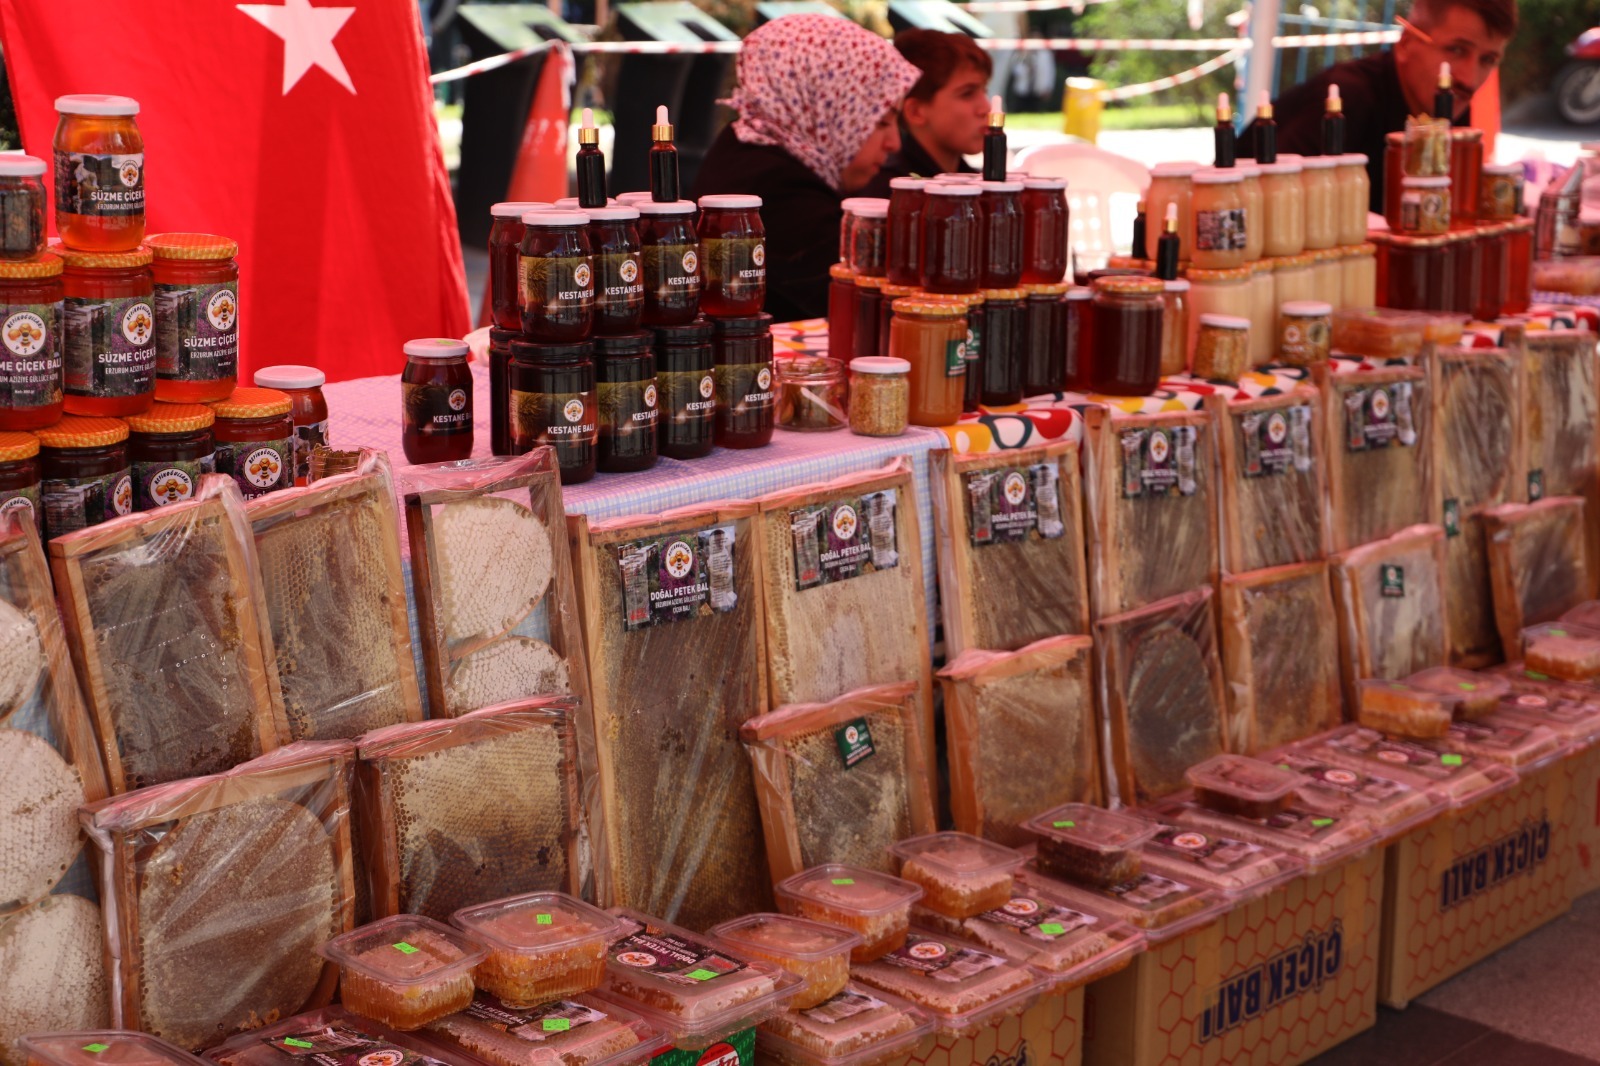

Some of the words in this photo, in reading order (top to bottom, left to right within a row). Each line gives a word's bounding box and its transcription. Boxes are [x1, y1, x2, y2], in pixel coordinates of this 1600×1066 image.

[91, 190, 122, 201] SÜZME
[124, 190, 142, 201] ÇİÇEK
[740, 269, 764, 278] KESTANE
[668, 276, 696, 286] KESTANE
[559, 290, 589, 300] KESTANE
[605, 285, 636, 296] KESTANE
[184, 336, 216, 348] SÜZME
[99, 351, 132, 363] SÜZME
[134, 348, 153, 362] ÇİÇEK
[16, 359, 45, 372] ÇİÇEK
[47, 358, 61, 369] BALI
[745, 392, 769, 402] KESTANE
[686, 400, 712, 411] KESTANE
[433, 413, 465, 423] KESTANE
[632, 409, 656, 421] KESTANE
[547, 425, 582, 434] KESTANE
[820, 550, 840, 562] DOĞAL
[841, 545, 860, 557] PETEK
[860, 542, 871, 552] BAL
[650, 588, 673, 601] DOĞAL
[674, 584, 696, 596] PETEK
[697, 582, 709, 592] BAL
[1441, 850, 1489, 907] BALI
[630, 936, 646, 944] BAL
[643, 941, 670, 954] PETEK
[670, 951, 696, 964] DOĞAL
[1267, 918, 1343, 1006] ÇİÇEK
